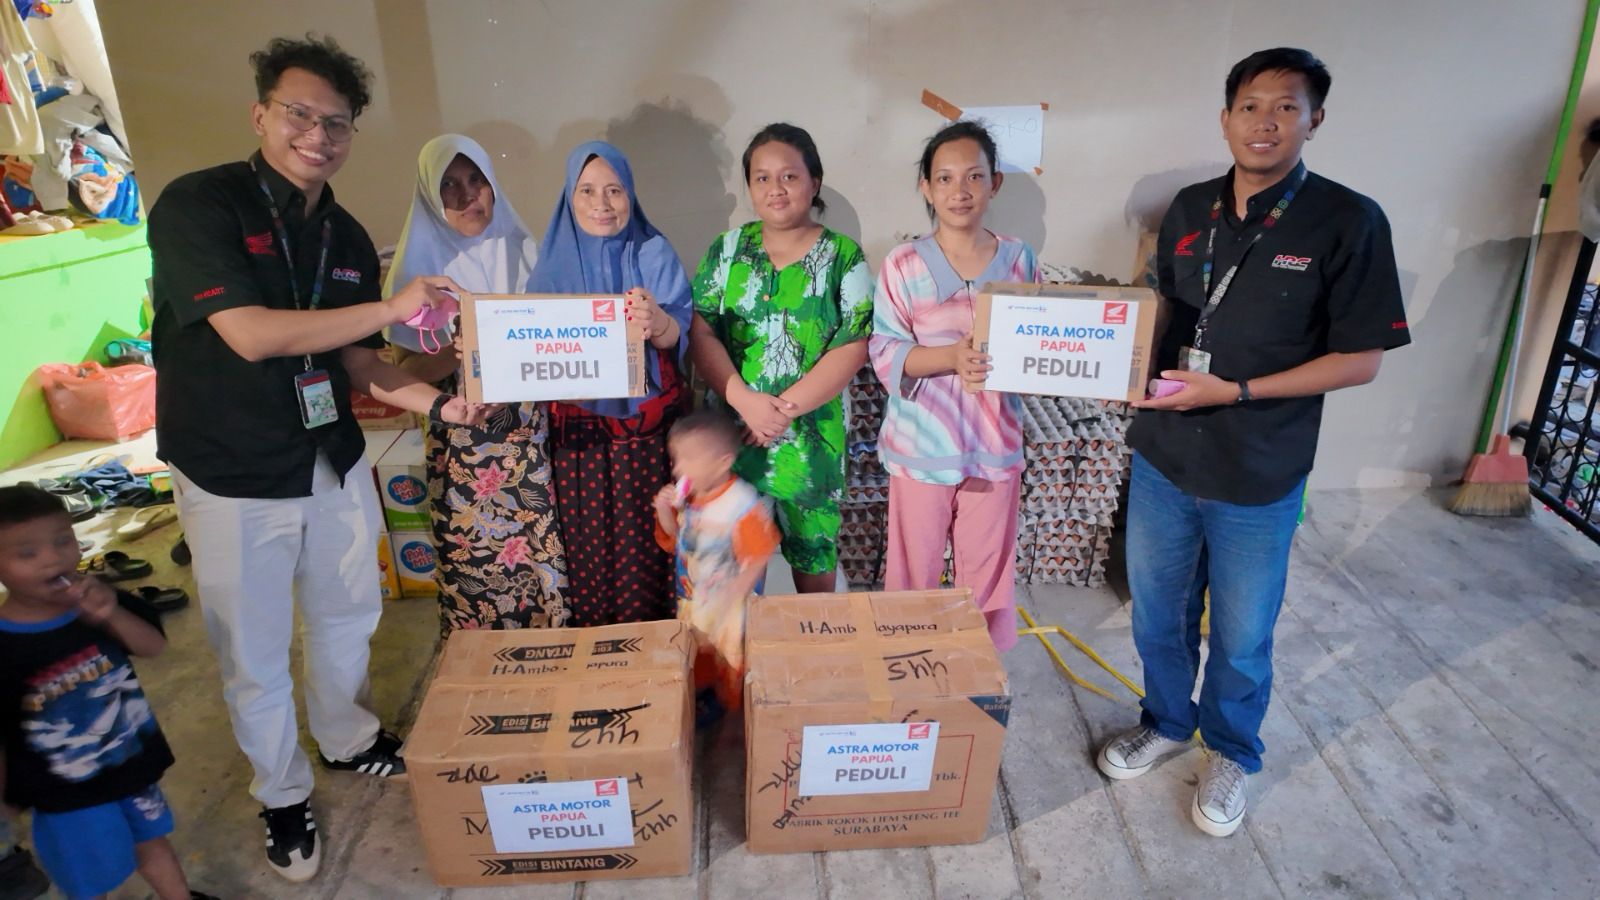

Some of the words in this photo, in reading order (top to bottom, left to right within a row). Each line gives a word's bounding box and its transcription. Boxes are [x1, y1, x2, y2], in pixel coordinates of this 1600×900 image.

[506, 328, 553, 340] ASTRA
[557, 326, 608, 338] MOTOR
[1015, 324, 1060, 338] ASTRA
[1063, 327, 1114, 339] MOTOR
[535, 343, 582, 354] PAPUA
[1040, 340, 1086, 353] PAPUA
[520, 360, 599, 381] PEDULI
[1022, 356, 1100, 379] PEDULI
[405, 546, 425, 561] POP
[525, 645, 574, 659] NTANG
[502, 718, 529, 727] EDISI
[827, 744, 869, 754] ASTRA
[872, 743, 920, 753] MOTOR
[851, 754, 893, 763] PAPUA
[835, 766, 907, 782] PEDULI
[513, 803, 558, 813] ASTRA
[561, 799, 611, 811] MOTOR
[541, 811, 587, 822] PAPUA
[528, 823, 604, 840] PEDULI
[834, 823, 908, 836] SURABAYA
[512, 861, 538, 869] EDISI
[541, 857, 606, 871] BINTANG
